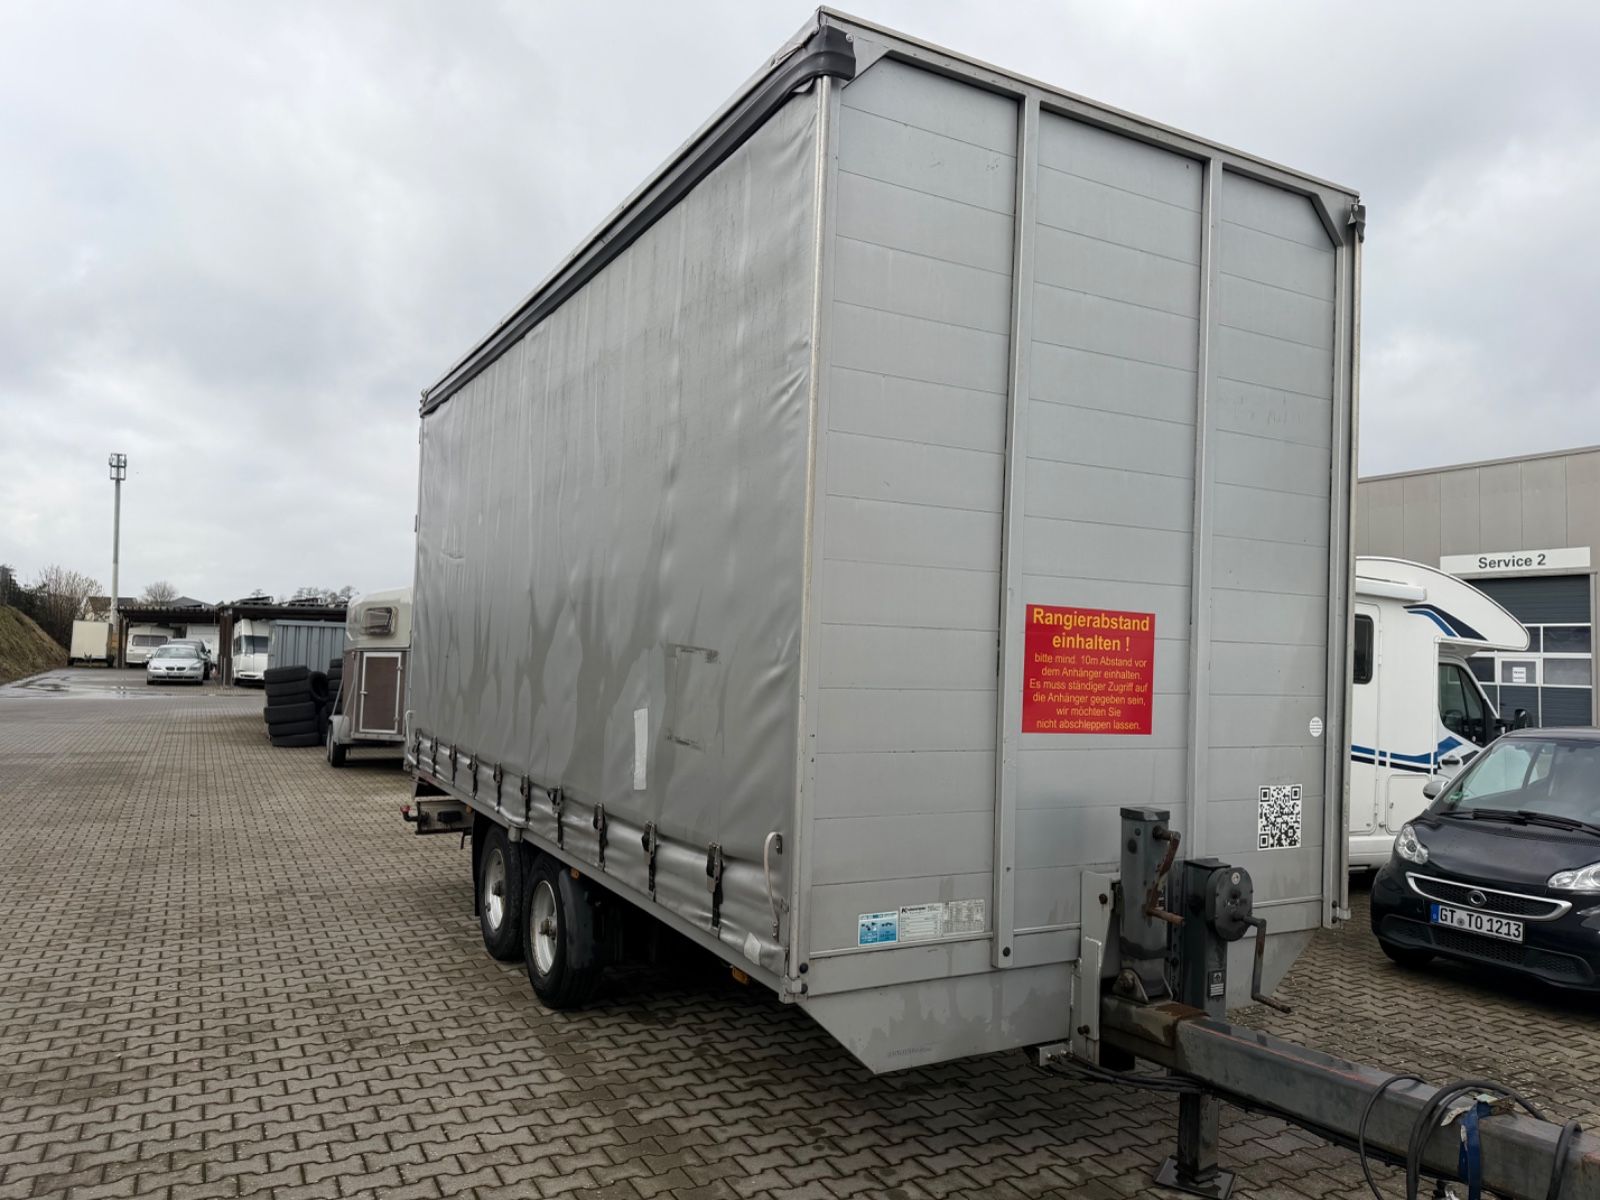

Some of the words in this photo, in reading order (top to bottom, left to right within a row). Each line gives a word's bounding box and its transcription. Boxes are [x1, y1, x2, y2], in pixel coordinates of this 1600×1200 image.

[1478, 555, 1533, 569] Service
[1537, 553, 1546, 566] 2
[1033, 607, 1150, 631] Rangierabstand
[1052, 632, 1121, 651] einhalten
[1125, 636, 1130, 651] !
[1034, 652, 1053, 663] bitte
[1081, 655, 1099, 665] 10m
[1100, 656, 1133, 667] Abstand
[1134, 659, 1147, 668] vor
[1041, 666, 1060, 676] dem
[1061, 667, 1102, 680] Anhänger
[1103, 669, 1143, 680] einhalten.
[1029, 678, 1041, 689] Es
[1043, 681, 1066, 690] muss
[1068, 680, 1106, 693] ständiger
[1107, 681, 1134, 694] Zugriff
[1135, 682, 1148, 693] auf
[1032, 692, 1046, 702] die
[1047, 692, 1088, 706] Anhänger
[1090, 694, 1126, 707] gegeben
[1127, 695, 1146, 706] sein,
[1056, 706, 1069, 716] wir
[1070, 706, 1107, 717] möchten
[1108, 706, 1121, 717] Sie
[1036, 719, 1057, 729] nicht
[1059, 719, 1111, 731] abschleppen
[1113, 720, 1141, 730] lassen.
[1440, 907, 1456, 924] GT
[1466, 912, 1483, 930] TO
[1486, 918, 1521, 938] 1213
